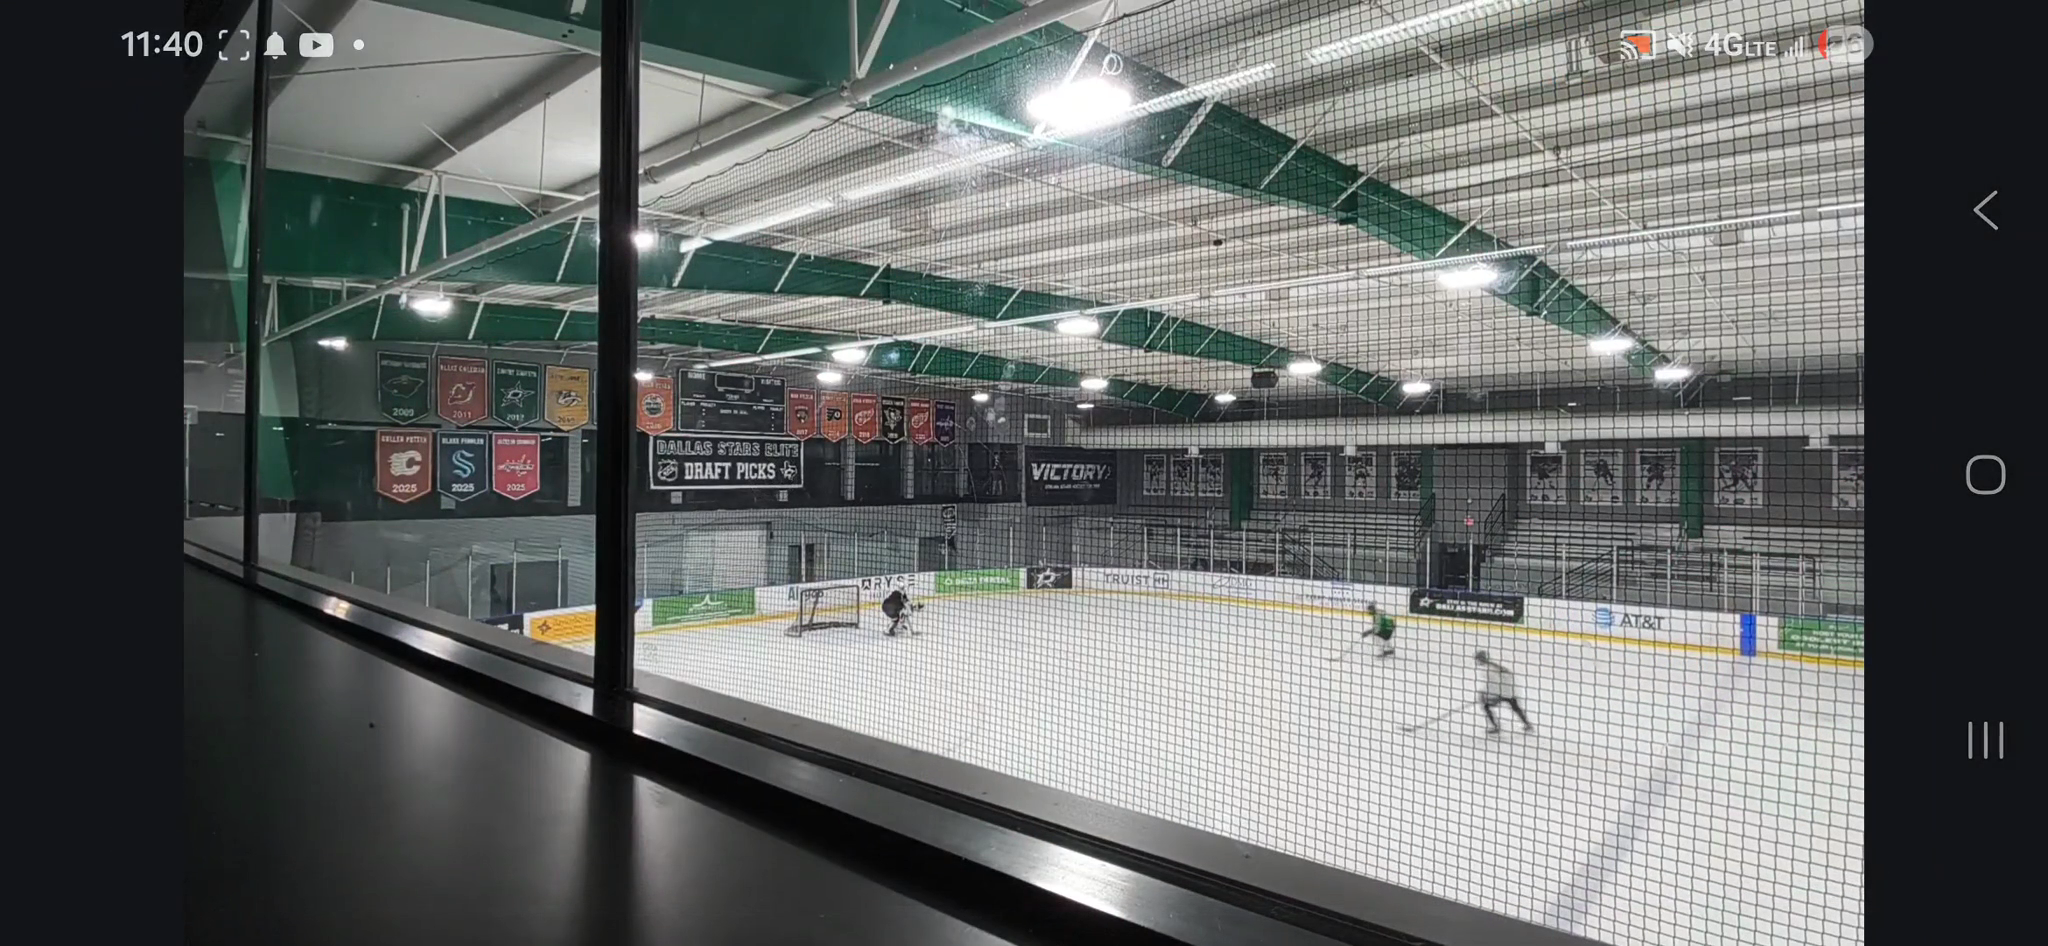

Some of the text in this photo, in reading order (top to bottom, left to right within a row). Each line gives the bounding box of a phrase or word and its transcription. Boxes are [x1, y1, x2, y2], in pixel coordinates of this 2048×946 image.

[656, 439, 799, 458] DALLAS STARS ELITE
[683, 461, 776, 480] DRAFT PICKS
[392, 484, 417, 493] 2025
[451, 484, 475, 492] 2025
[506, 483, 526, 492] 2025
[1104, 573, 1151, 585] TRUIST
[1620, 613, 1665, 630] AT&T
